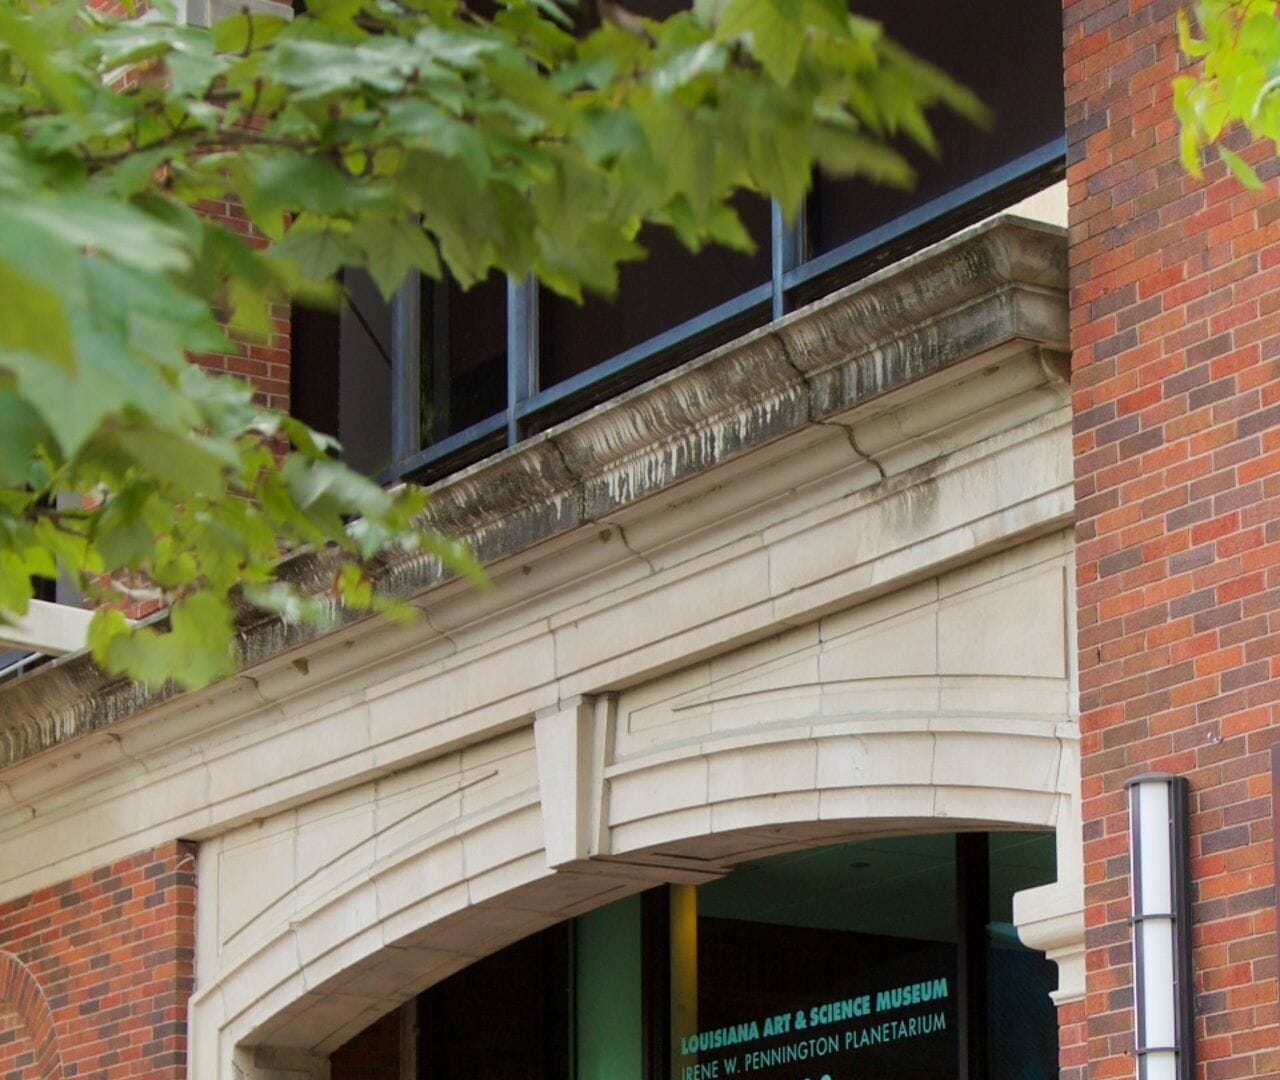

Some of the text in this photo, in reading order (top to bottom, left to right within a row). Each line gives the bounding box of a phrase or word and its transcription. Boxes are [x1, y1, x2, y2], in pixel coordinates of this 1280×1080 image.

[681, 977, 949, 1054] LOUISIANA ART & SCIENCE MUSEUM
[723, 1057, 741, 1075] W.
[744, 1035, 840, 1072] PENNINGTON
[845, 1011, 947, 1050] PLANETARIUM
